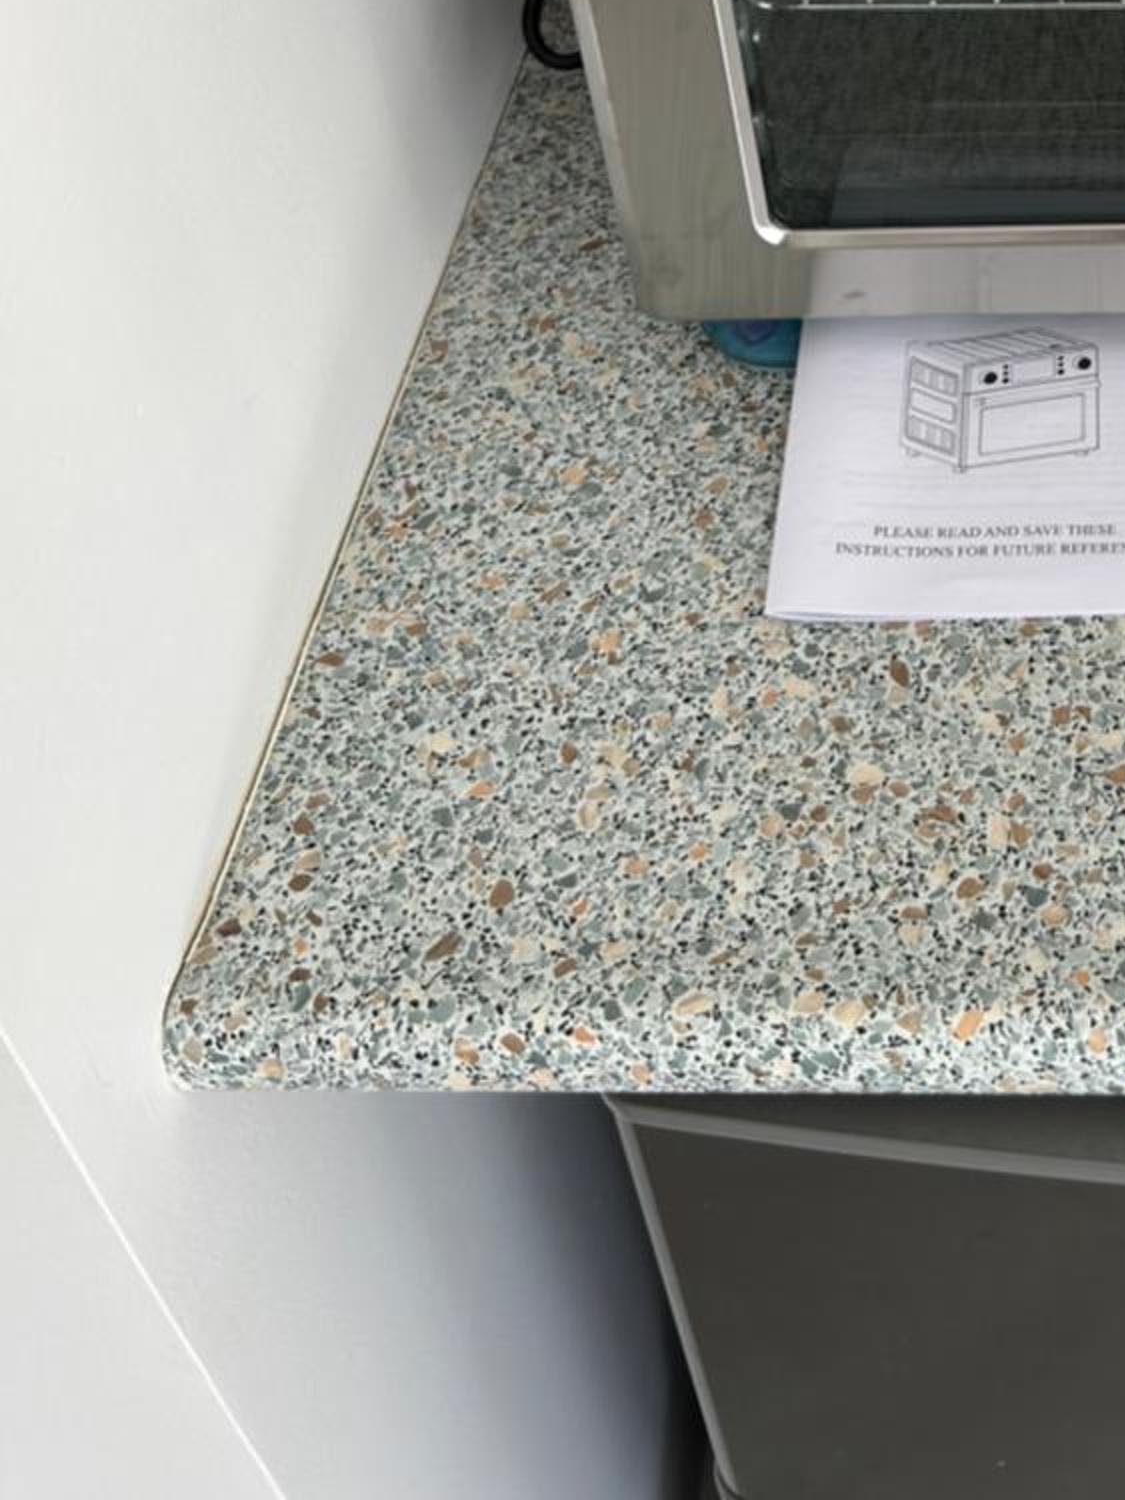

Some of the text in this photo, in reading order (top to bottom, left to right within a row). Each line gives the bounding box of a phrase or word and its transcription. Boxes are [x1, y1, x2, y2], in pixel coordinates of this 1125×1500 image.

[873, 523, 1116, 539] PLEASE READ AND SAVE THESE
[835, 542, 954, 558] INSTRUCTIONS
[956, 544, 989, 558] FOR
[992, 543, 1054, 557] FUTURE
